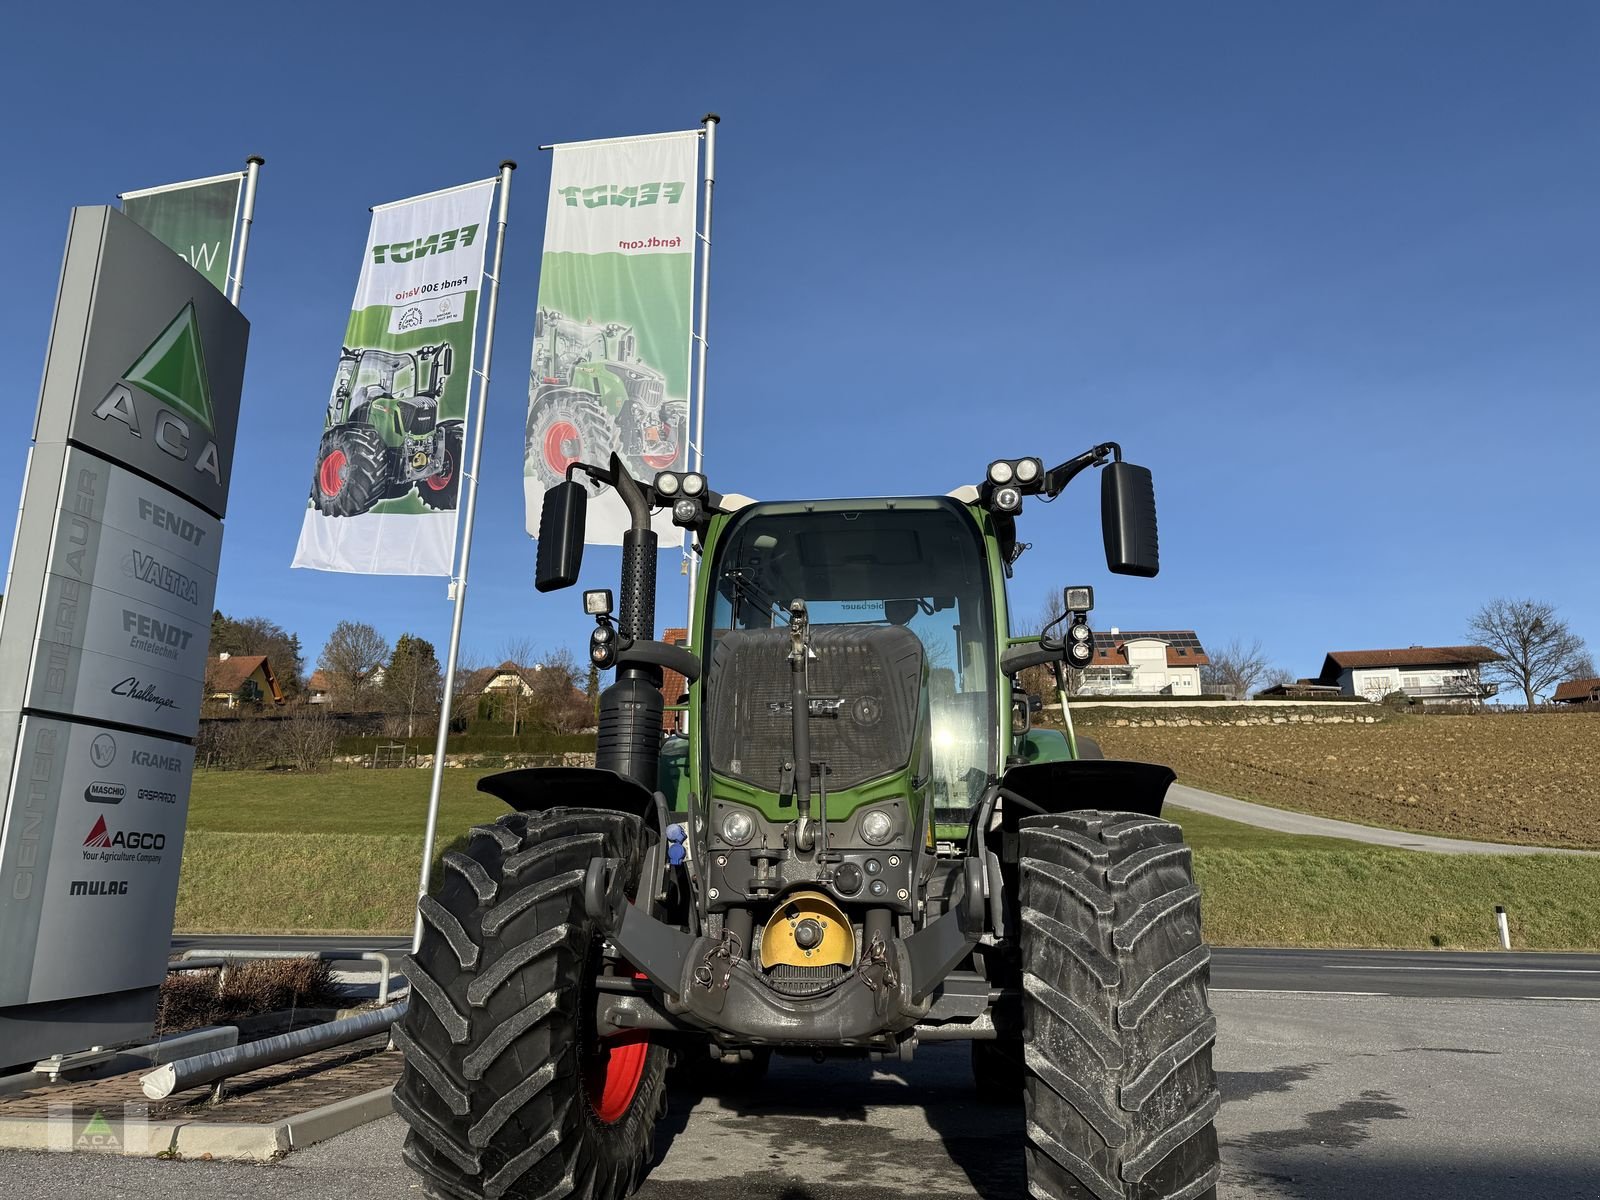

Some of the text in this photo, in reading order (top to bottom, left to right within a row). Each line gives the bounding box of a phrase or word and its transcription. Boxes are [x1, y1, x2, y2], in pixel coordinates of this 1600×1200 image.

[92, 382, 222, 487] ACA
[138, 497, 207, 548] FENDT
[132, 549, 198, 606] VALTRA
[122, 609, 193, 650] FENDT
[130, 635, 179, 661] Erntetechnik
[111, 677, 181, 712] Challenger
[131, 750, 182, 773] KRAMER
[91, 785, 125, 796] MASCHIO
[137, 788, 177, 804] GASPARDO
[13, 728, 57, 900] CENTER
[111, 831, 166, 850] AGCO
[82, 851, 162, 864] Your Agriculture Company
[69, 881, 129, 896] MULAG
